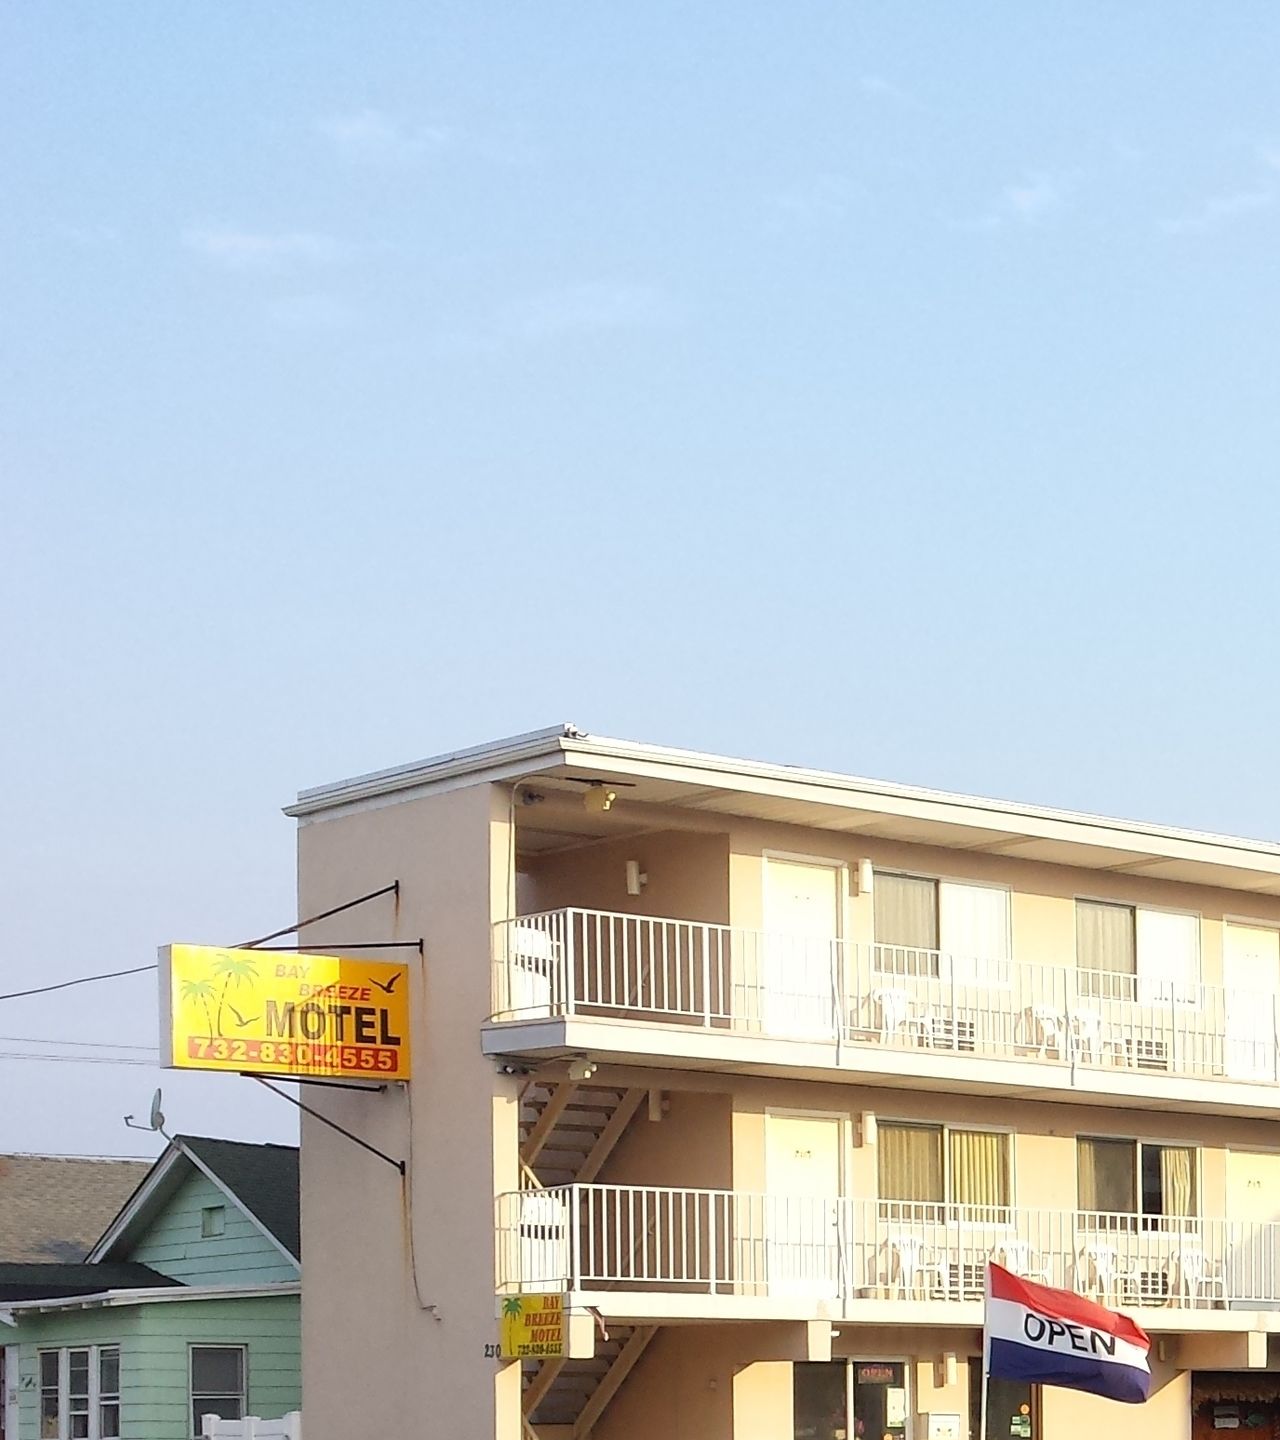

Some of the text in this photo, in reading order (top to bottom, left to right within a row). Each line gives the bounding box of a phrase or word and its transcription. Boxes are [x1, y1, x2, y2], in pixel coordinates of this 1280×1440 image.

[275, 964, 310, 979] BAY
[298, 984, 372, 1001] BREEZE
[266, 1000, 401, 1046] MOTEL
[193, 1038, 392, 1070] 732-830-4555
[543, 1296, 560, 1309] BAY
[524, 1312, 561, 1327] BREEZE
[529, 1328, 561, 1343] MOTEL
[1024, 1313, 1116, 1356] OPEN
